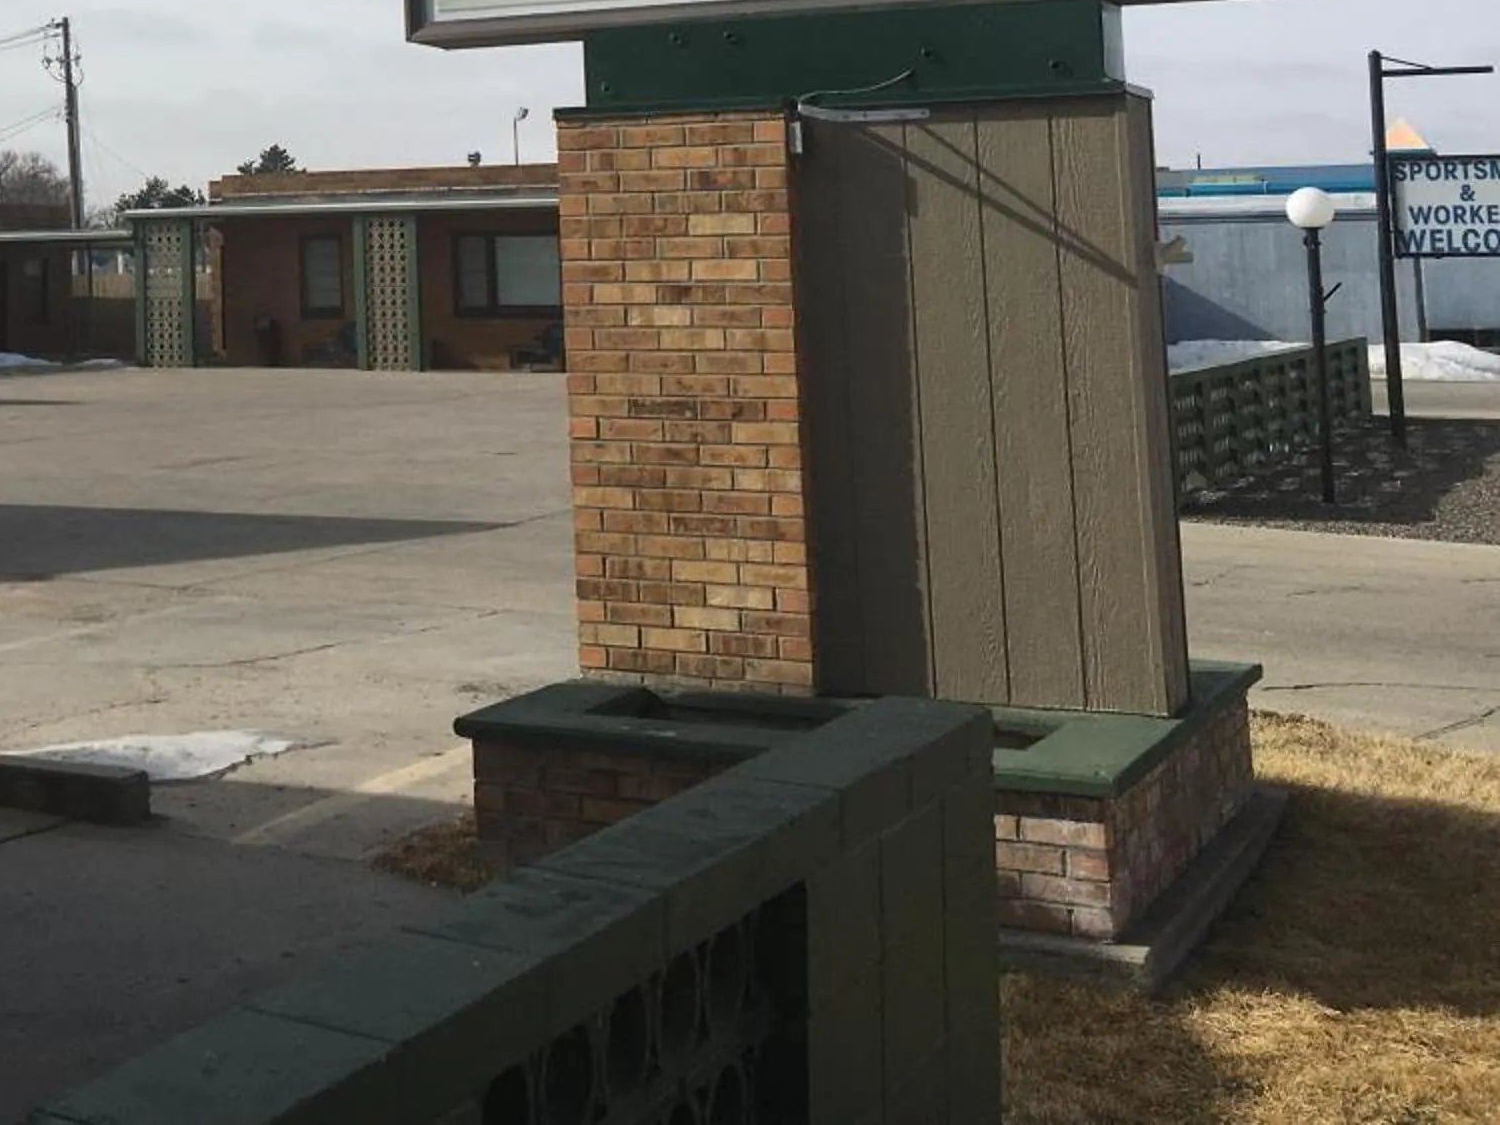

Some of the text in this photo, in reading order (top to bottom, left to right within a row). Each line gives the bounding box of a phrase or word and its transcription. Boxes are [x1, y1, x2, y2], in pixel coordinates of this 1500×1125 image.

[1460, 184, 1476, 202] &
[1409, 204, 1500, 225] WORKE
[1399, 228, 1500, 252] WELCO
